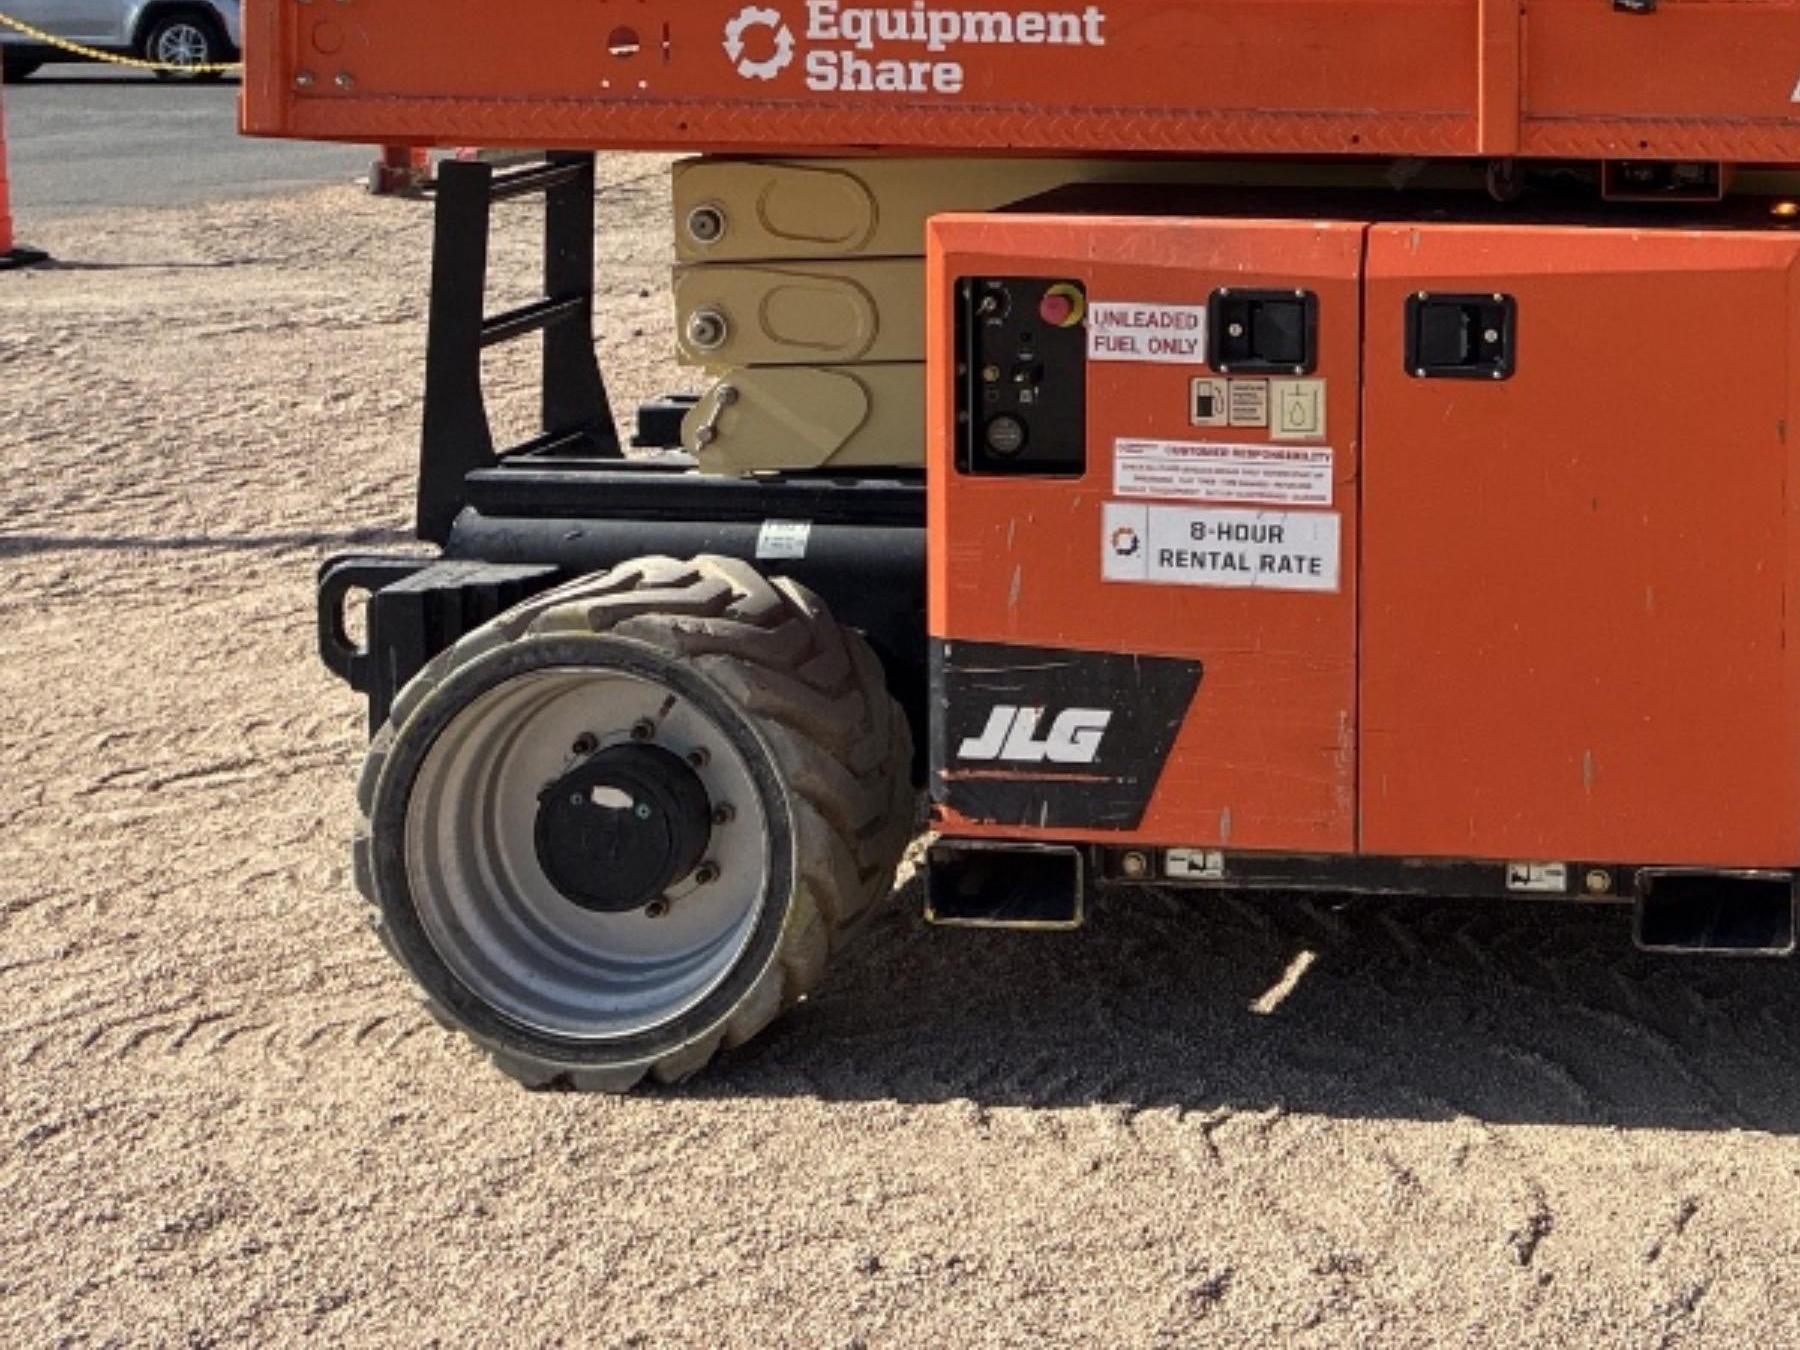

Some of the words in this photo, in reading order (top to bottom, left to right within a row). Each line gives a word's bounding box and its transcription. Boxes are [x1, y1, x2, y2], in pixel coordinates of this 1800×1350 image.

[805, 50, 964, 93] Share
[1094, 310, 1198, 330] UNLEADED
[1095, 336, 1141, 353] FUEL
[1149, 338, 1199, 355] ONLY
[1190, 521, 1285, 544] 8-HOUR
[1160, 549, 1252, 571] RENTAL
[1259, 554, 1323, 576] RATE
[957, 704, 1113, 763] JLG
